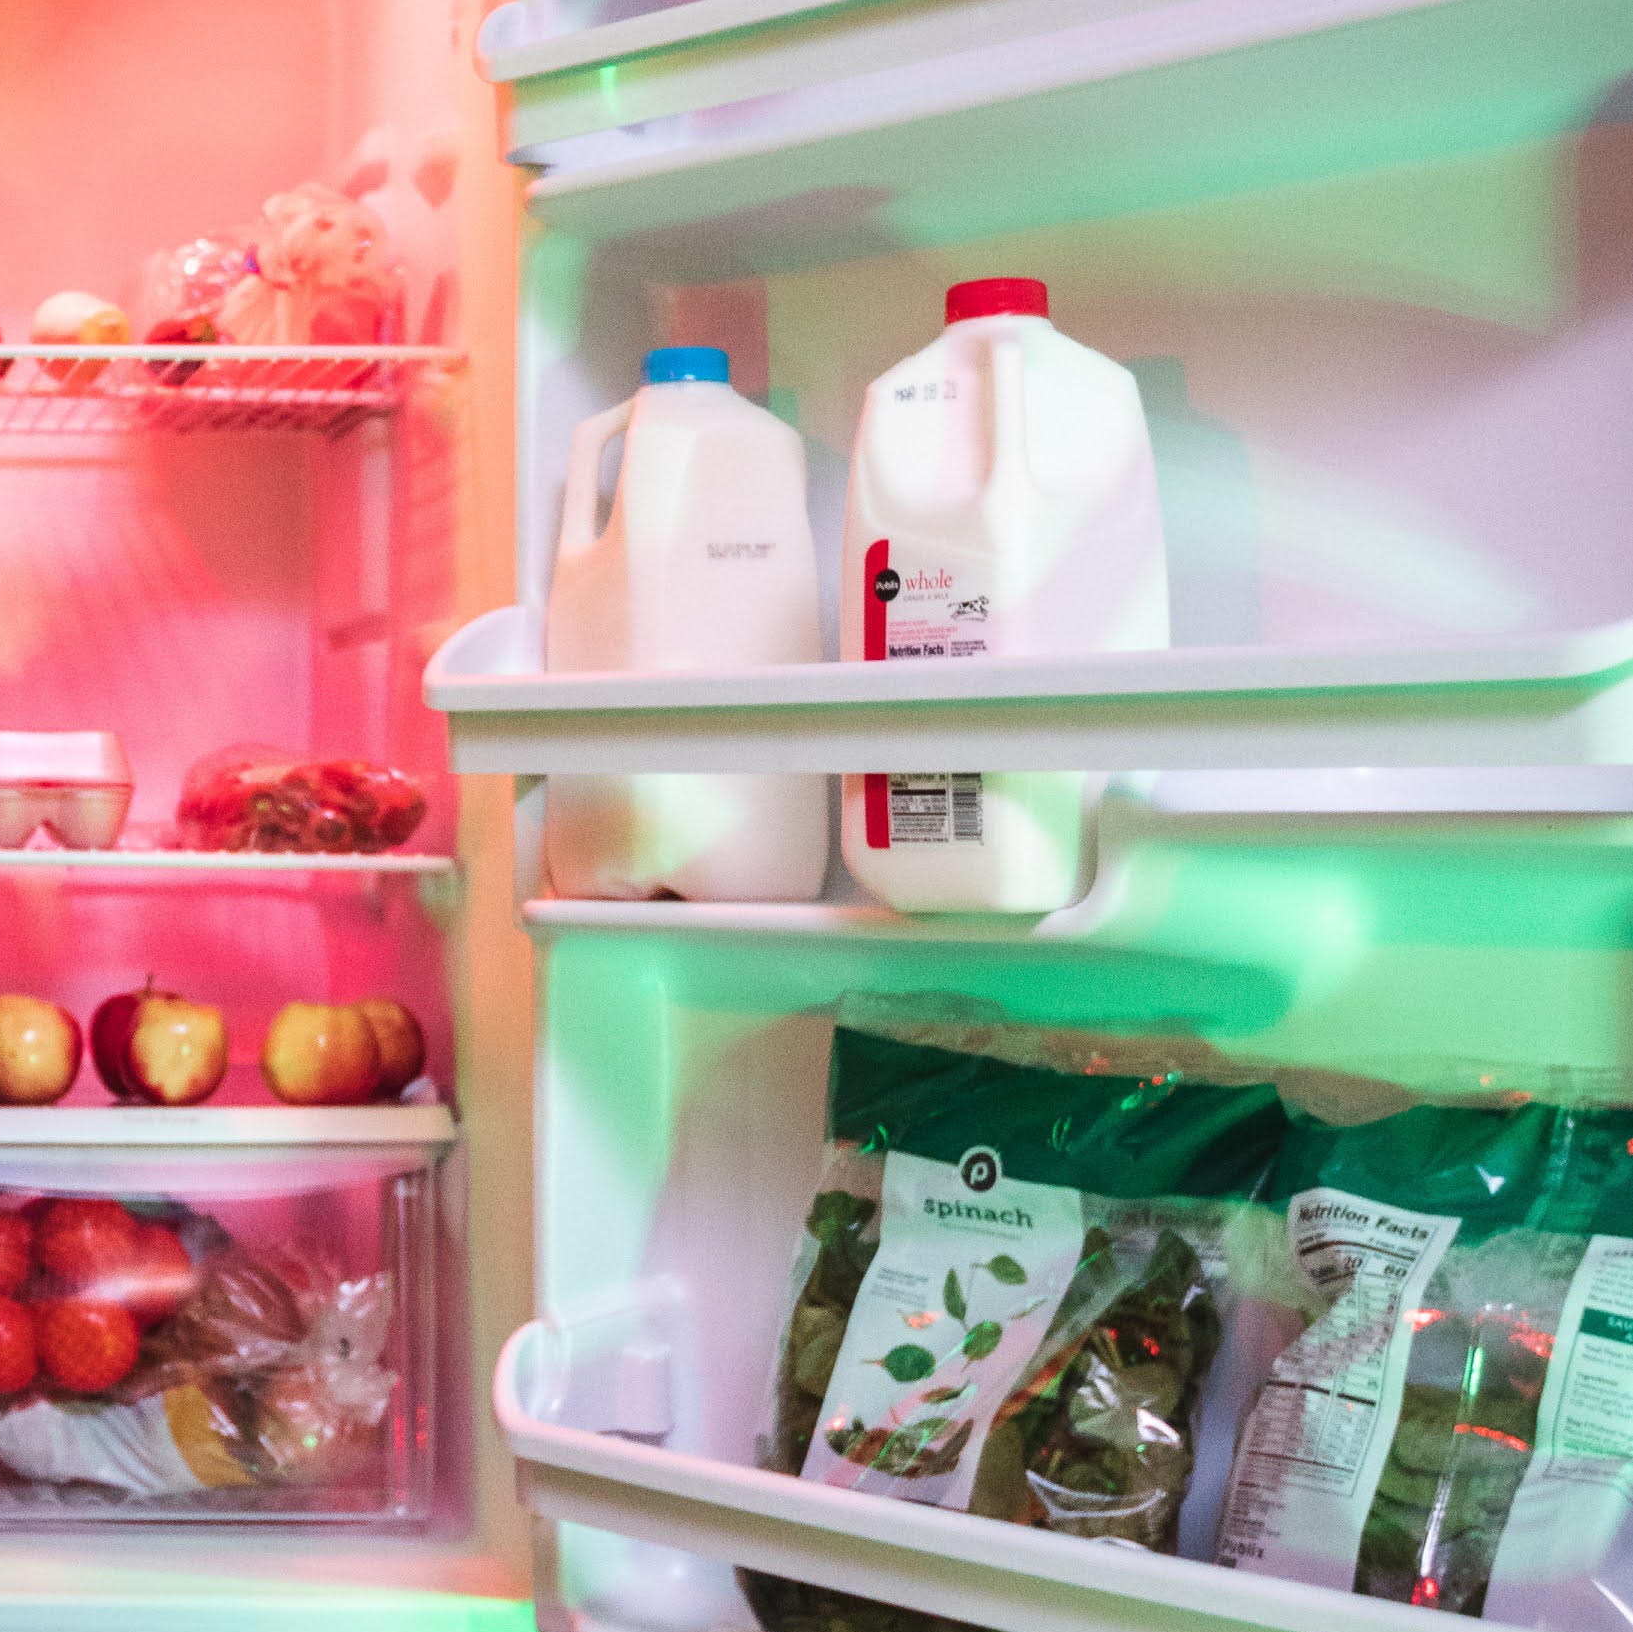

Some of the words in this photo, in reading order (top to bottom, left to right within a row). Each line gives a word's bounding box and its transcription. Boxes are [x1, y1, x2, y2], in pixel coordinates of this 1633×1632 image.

[905, 568, 953, 590] whole
[889, 644, 921, 658] Nutrition
[923, 643, 944, 656] Facts
[923, 1198, 1034, 1229] spinach
[1298, 1203, 1370, 1224] Nutrition
[1374, 1216, 1430, 1241] Facts
